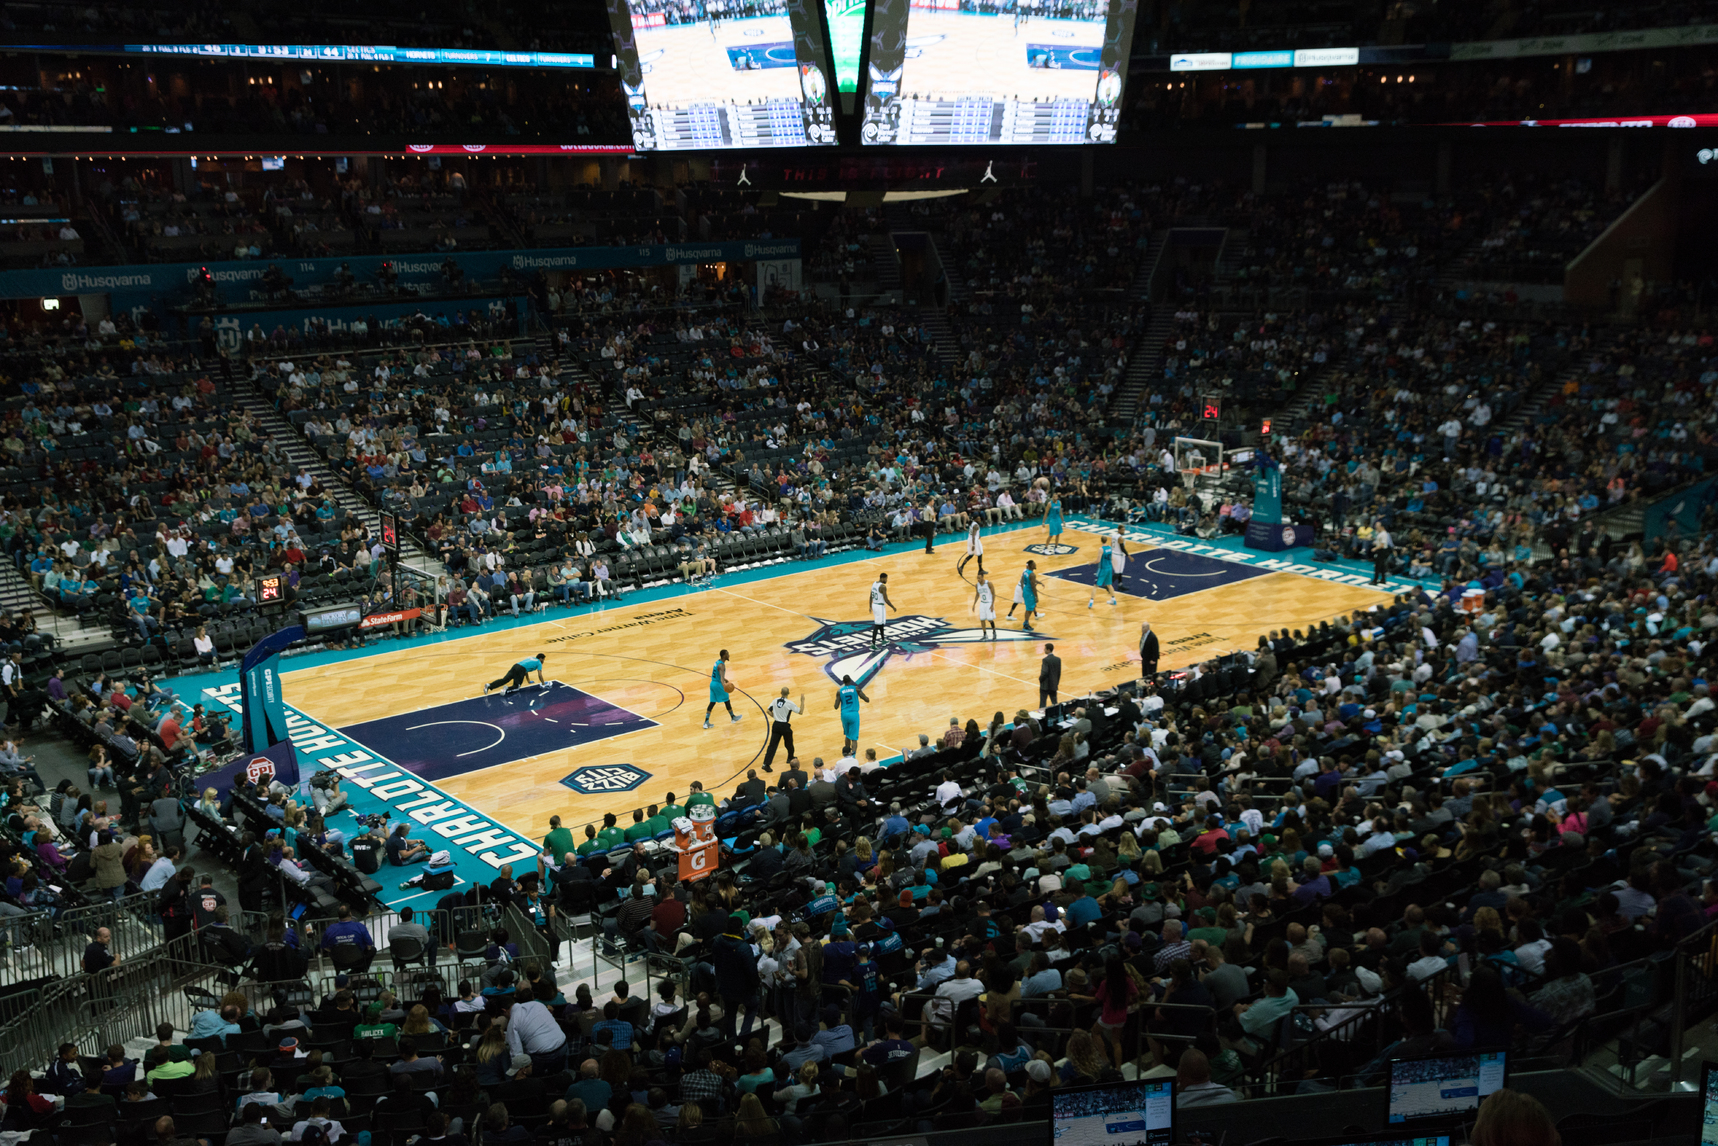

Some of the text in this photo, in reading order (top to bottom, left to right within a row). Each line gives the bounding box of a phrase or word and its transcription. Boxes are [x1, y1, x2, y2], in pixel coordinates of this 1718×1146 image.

[406, 51, 436, 59] HORNETS
[506, 54, 531, 63] CELTICS
[1235, 54, 1291, 66] FRIGIDAIRE
[675, 248, 722, 260] Husqvarna
[753, 245, 797, 256] Husqvarna
[300, 262, 315, 272] 114
[400, 261, 443, 274] Husqvar
[525, 255, 577, 268] Husqvarna
[78, 273, 151, 287] Husqvarna
[1204, 405, 1218, 418] 24
[384, 523, 396, 544] 24
[1061, 520, 1256, 562] CHARLOTTE
[262, 578, 279, 588] 9:53
[263, 587, 278, 599] 24
[634, 608, 684, 620] Arena
[597, 619, 655, 634] Warner
[545, 631, 595, 644] Cable
[845, 695, 853, 704] 2
[249, 765, 273, 778] CPI
[574, 767, 626, 783] CITY
[582, 771, 641, 791] BUZZ
[316, 749, 539, 870] CHARLOTTE
[691, 850, 706, 870] G
